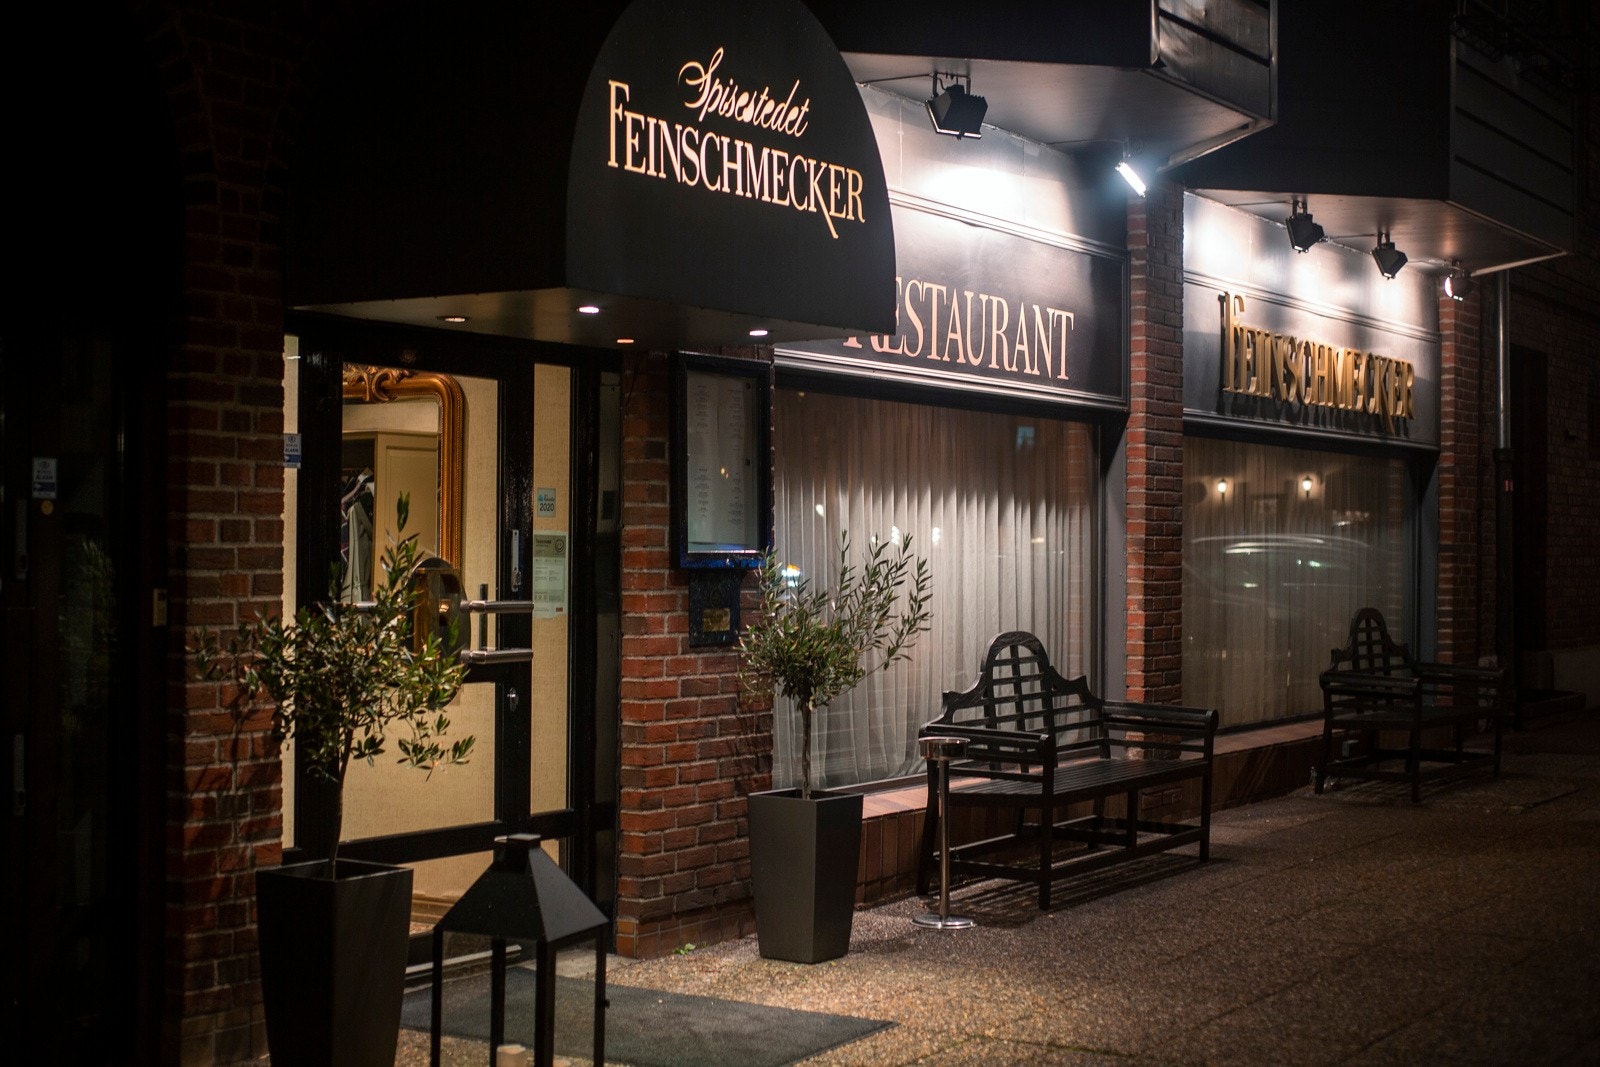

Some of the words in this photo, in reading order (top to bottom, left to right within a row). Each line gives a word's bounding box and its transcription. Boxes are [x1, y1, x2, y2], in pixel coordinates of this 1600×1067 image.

[678, 46, 811, 138] Spisestedet
[607, 79, 867, 240] FEINSCHMECKER
[843, 276, 1075, 381] STAURANT
[1221, 290, 1415, 435] FEINSCHMECKER
[539, 503, 555, 512] 2020
